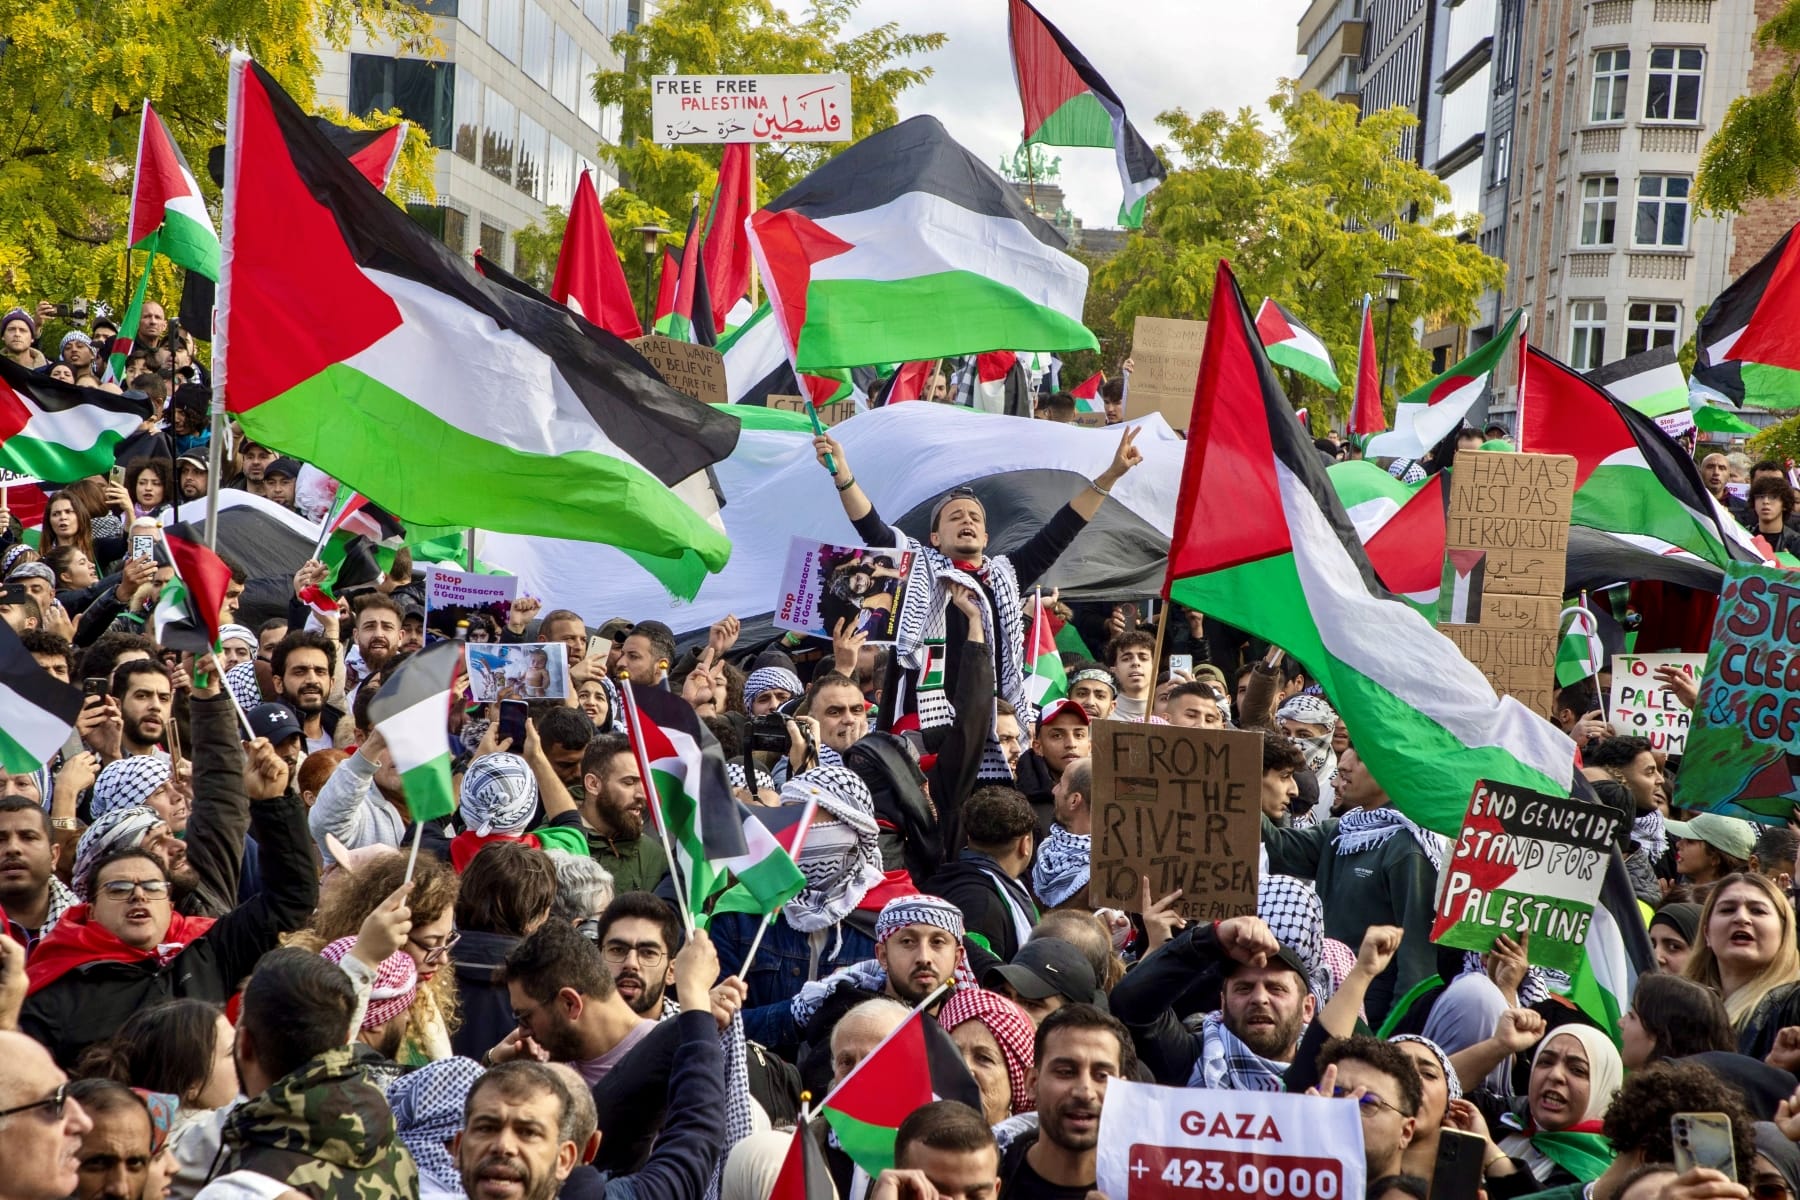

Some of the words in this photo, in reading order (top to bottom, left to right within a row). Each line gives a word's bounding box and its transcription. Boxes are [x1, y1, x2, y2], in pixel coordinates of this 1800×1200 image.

[656, 80, 702, 94] FREE
[716, 80, 757, 93] FREE
[681, 96, 768, 111] PALESTINA
[634, 340, 676, 355] SRAEL
[684, 345, 720, 364] WANTS
[663, 374, 678, 384] EY
[666, 357, 713, 378] BELIEVE
[774, 399, 825, 415] STP
[1472, 456, 1569, 488] HAMAS
[1458, 483, 1512, 513] N'EST
[1518, 486, 1557, 516] PAS
[1452, 517, 1569, 550] TERRORISTE
[434, 582, 451, 591] aux
[452, 585, 504, 597] massacres
[435, 572, 462, 585] Stop
[797, 551, 813, 606] massacres
[441, 590, 465, 601] Gaza
[780, 593, 796, 621] Stop
[802, 593, 814, 618] Gaza
[793, 607, 802, 623] aux
[1495, 630, 1558, 668] KILLERS
[1619, 656, 1648, 677] TO
[1620, 685, 1688, 712] PALE
[1709, 686, 1734, 725] &
[1615, 708, 1648, 726] TO
[1112, 732, 1230, 779] FROM
[1169, 779, 1246, 814] THE
[1101, 803, 1233, 858] RIVER
[1471, 787, 1517, 820] END
[1520, 801, 1620, 847] GENOCIDE
[1456, 827, 1544, 870] STAND
[1547, 844, 1600, 881] FOR
[1097, 859, 1138, 900] TO
[1442, 871, 1592, 945] PALESTINE
[1180, 1110, 1283, 1142] GAZA
[1161, 1158, 1338, 1200] 423.0000
